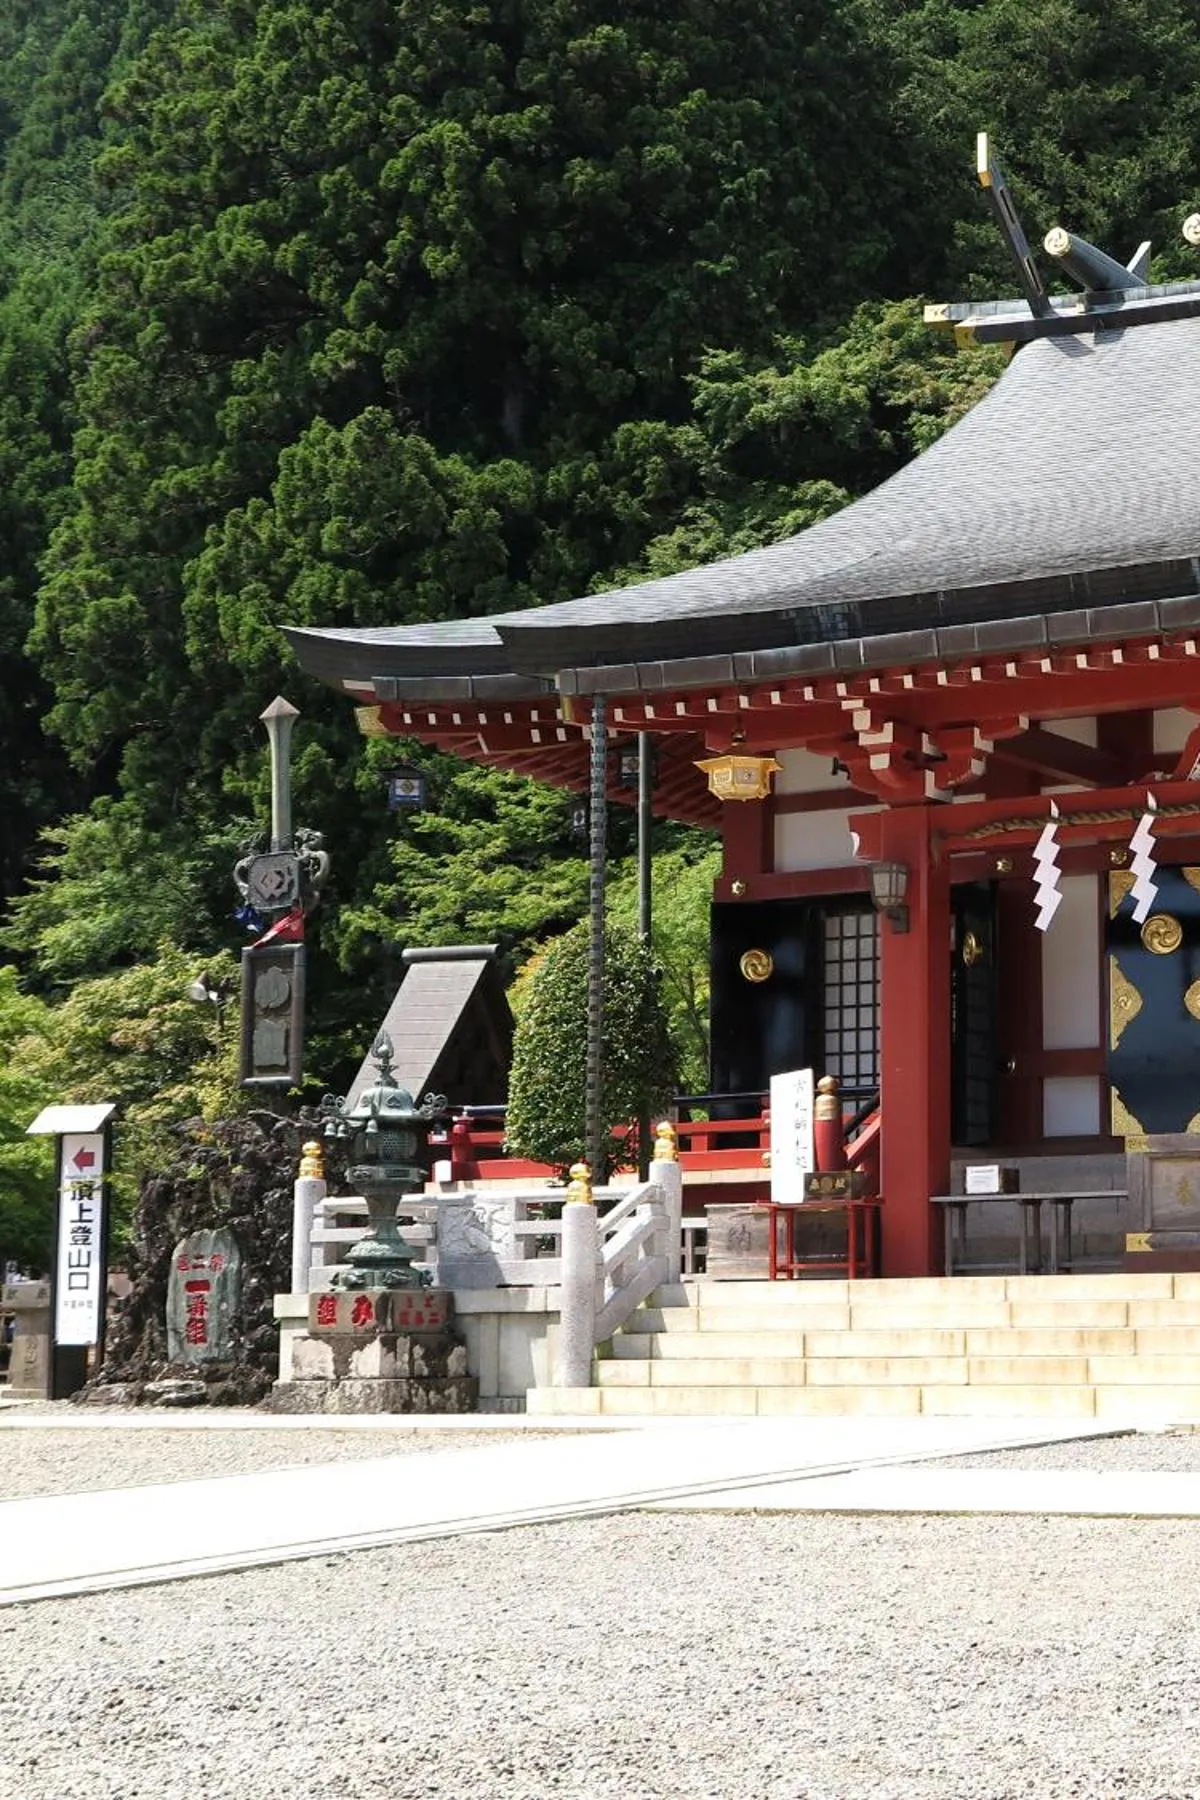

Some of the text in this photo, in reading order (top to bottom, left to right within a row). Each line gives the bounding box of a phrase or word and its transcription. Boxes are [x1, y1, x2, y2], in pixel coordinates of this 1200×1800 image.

[67, 1179, 95, 1291] 頂上登山口
